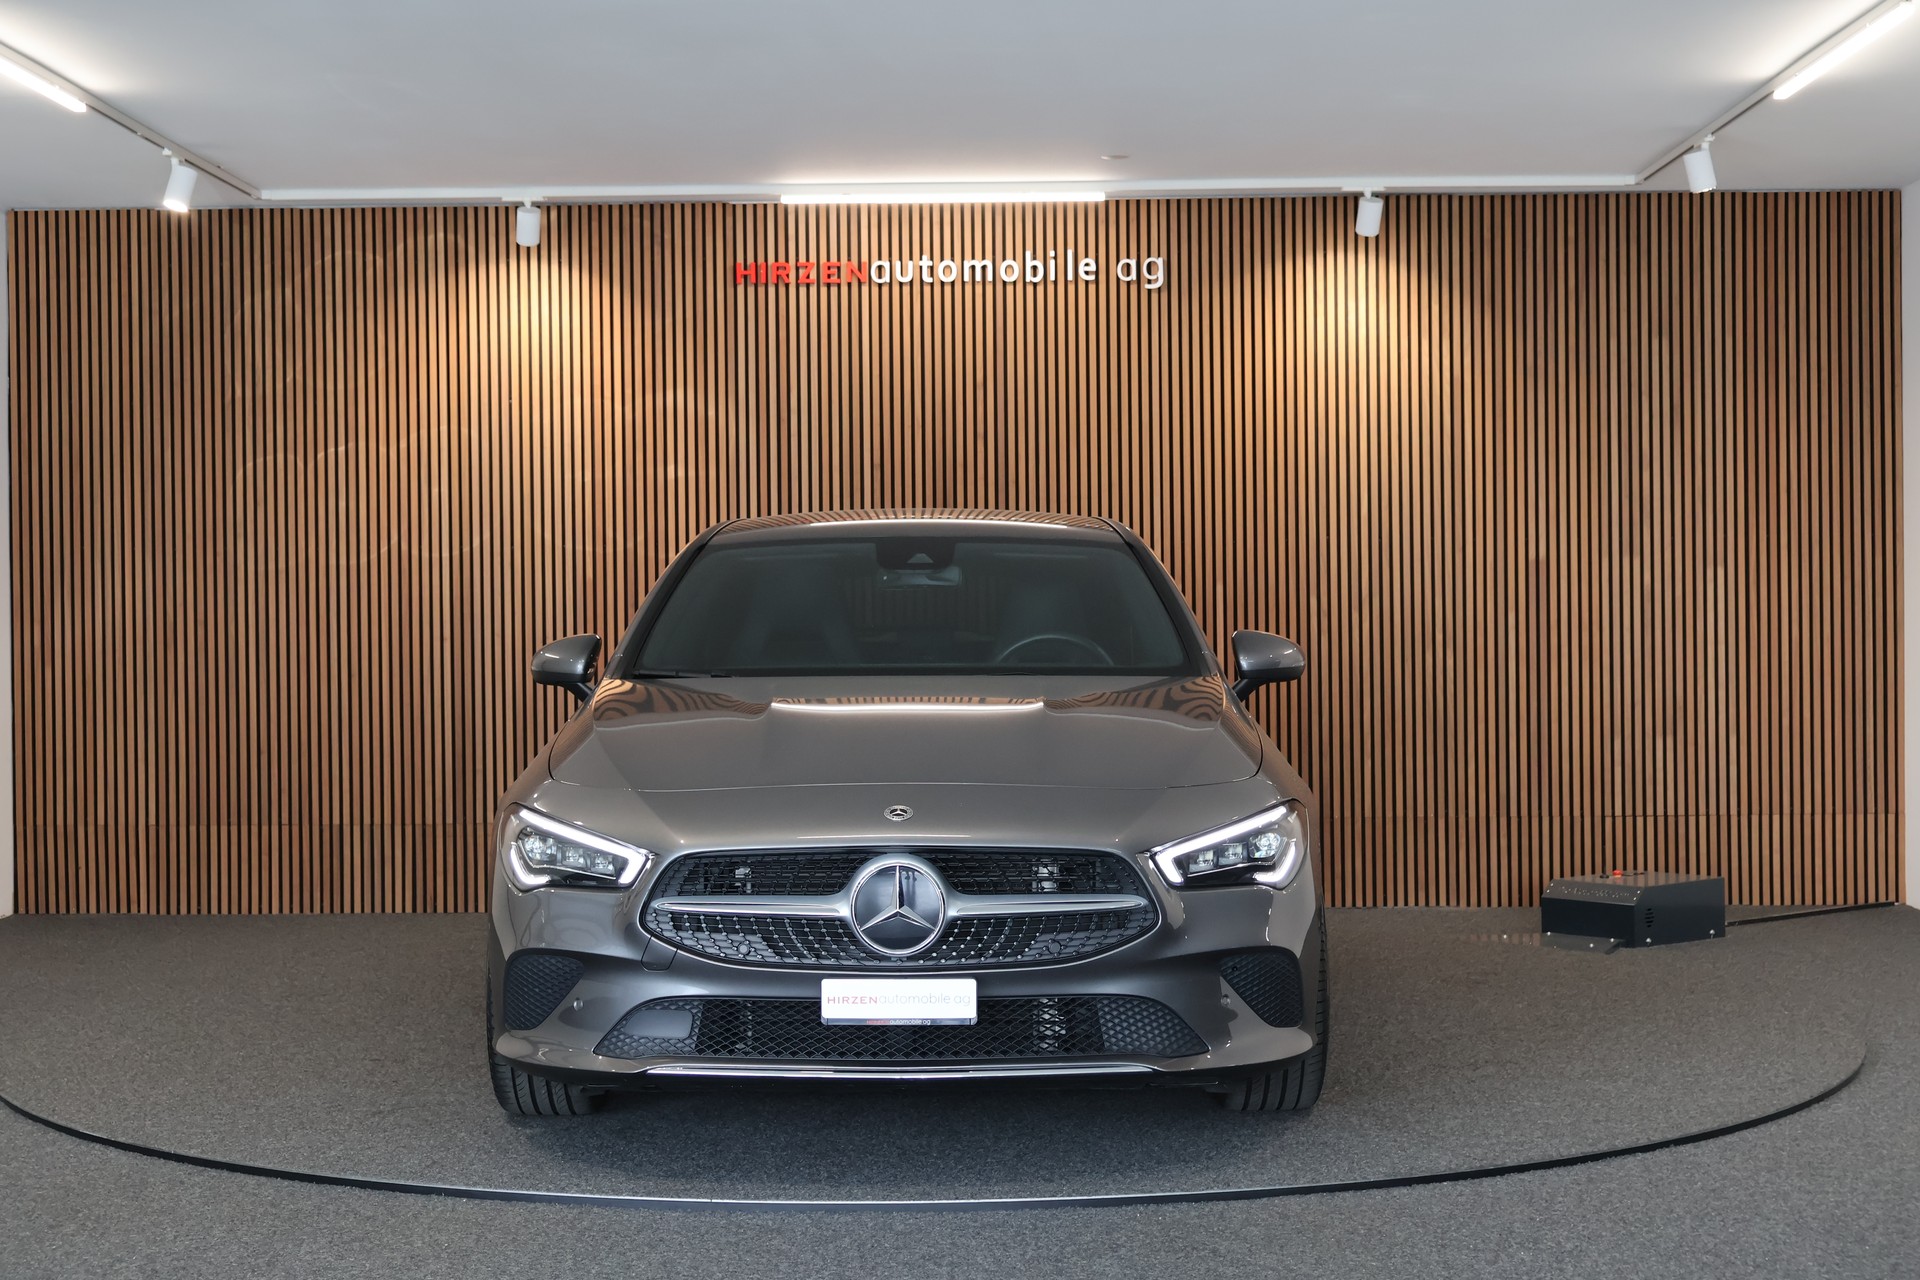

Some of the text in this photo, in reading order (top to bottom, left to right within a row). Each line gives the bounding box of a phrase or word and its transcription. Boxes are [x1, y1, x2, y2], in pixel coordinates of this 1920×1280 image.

[735, 249, 1165, 290] HIRZENautomobile ag
[827, 993, 971, 1007] HIRZENautomobile ag
